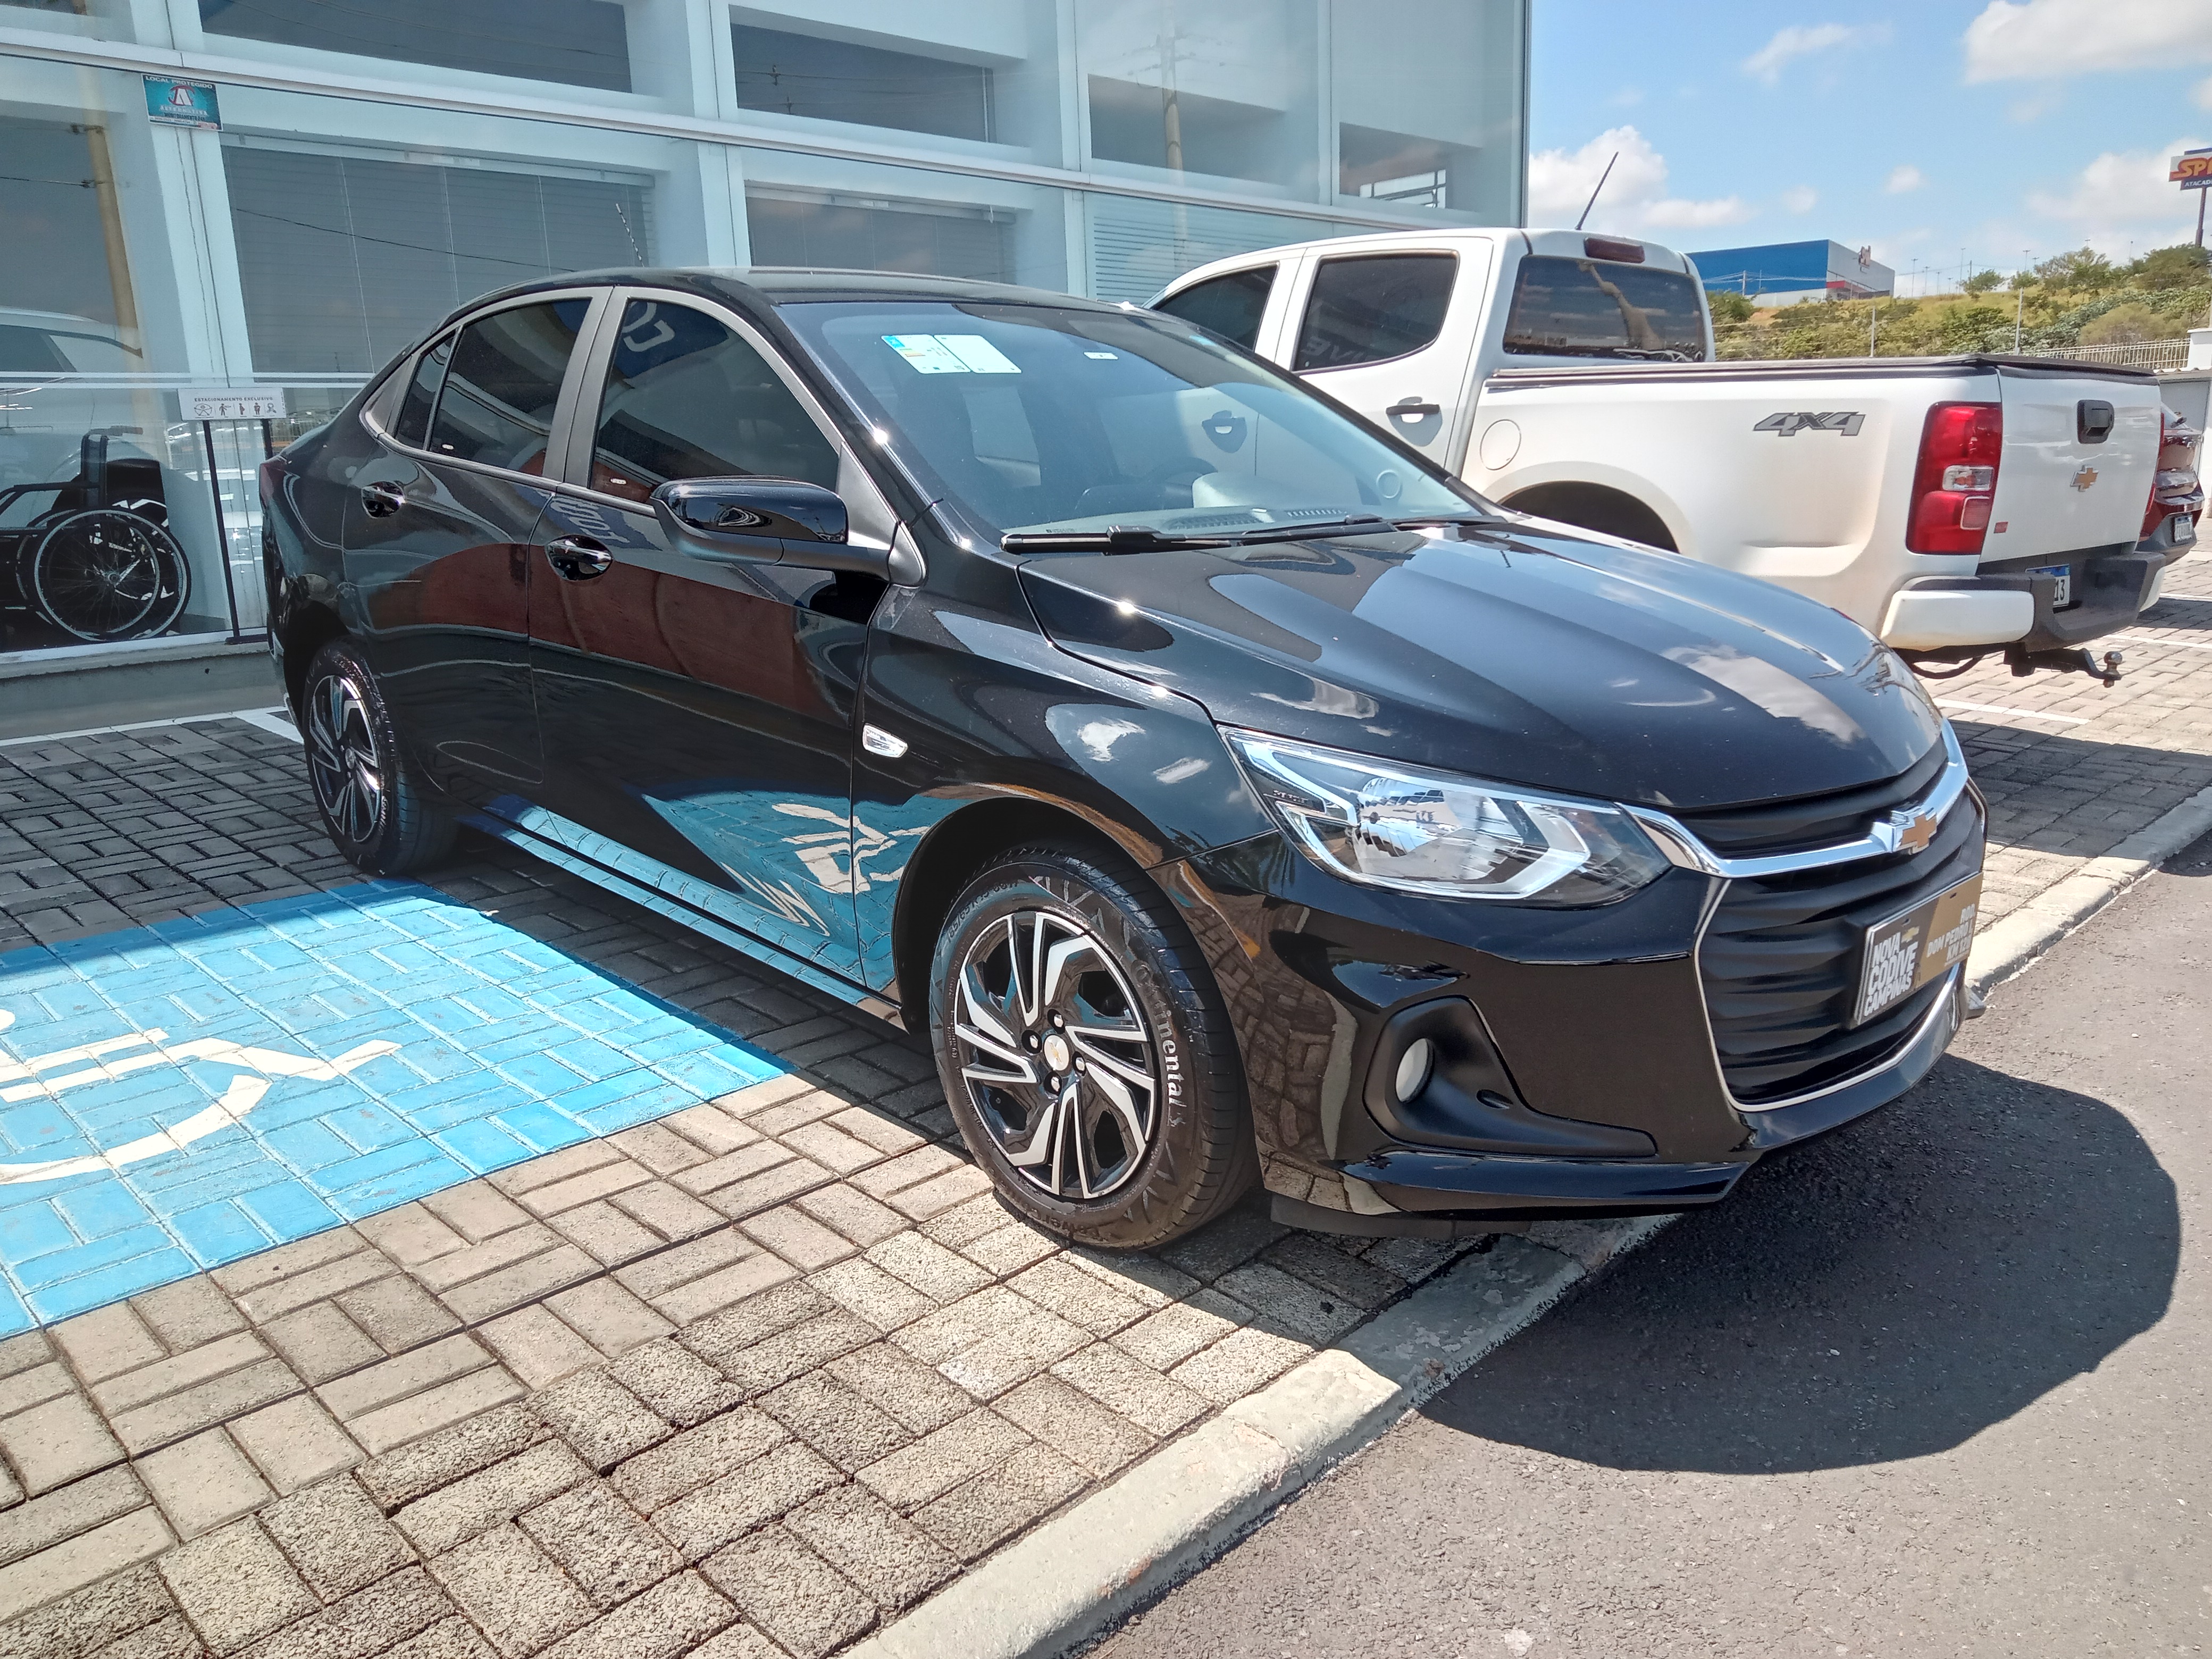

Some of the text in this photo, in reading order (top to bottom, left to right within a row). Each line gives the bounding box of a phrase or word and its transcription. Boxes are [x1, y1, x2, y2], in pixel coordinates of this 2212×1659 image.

[172, 79, 213, 89] PROTEGIDO
[1872, 932, 1901, 968] NOVA
[1926, 934, 1945, 958] DOM
[1945, 920, 1969, 948] PEDRO
[1868, 941, 1918, 995] CODIVE
[1864, 970, 1913, 1017] CAMPINAS
